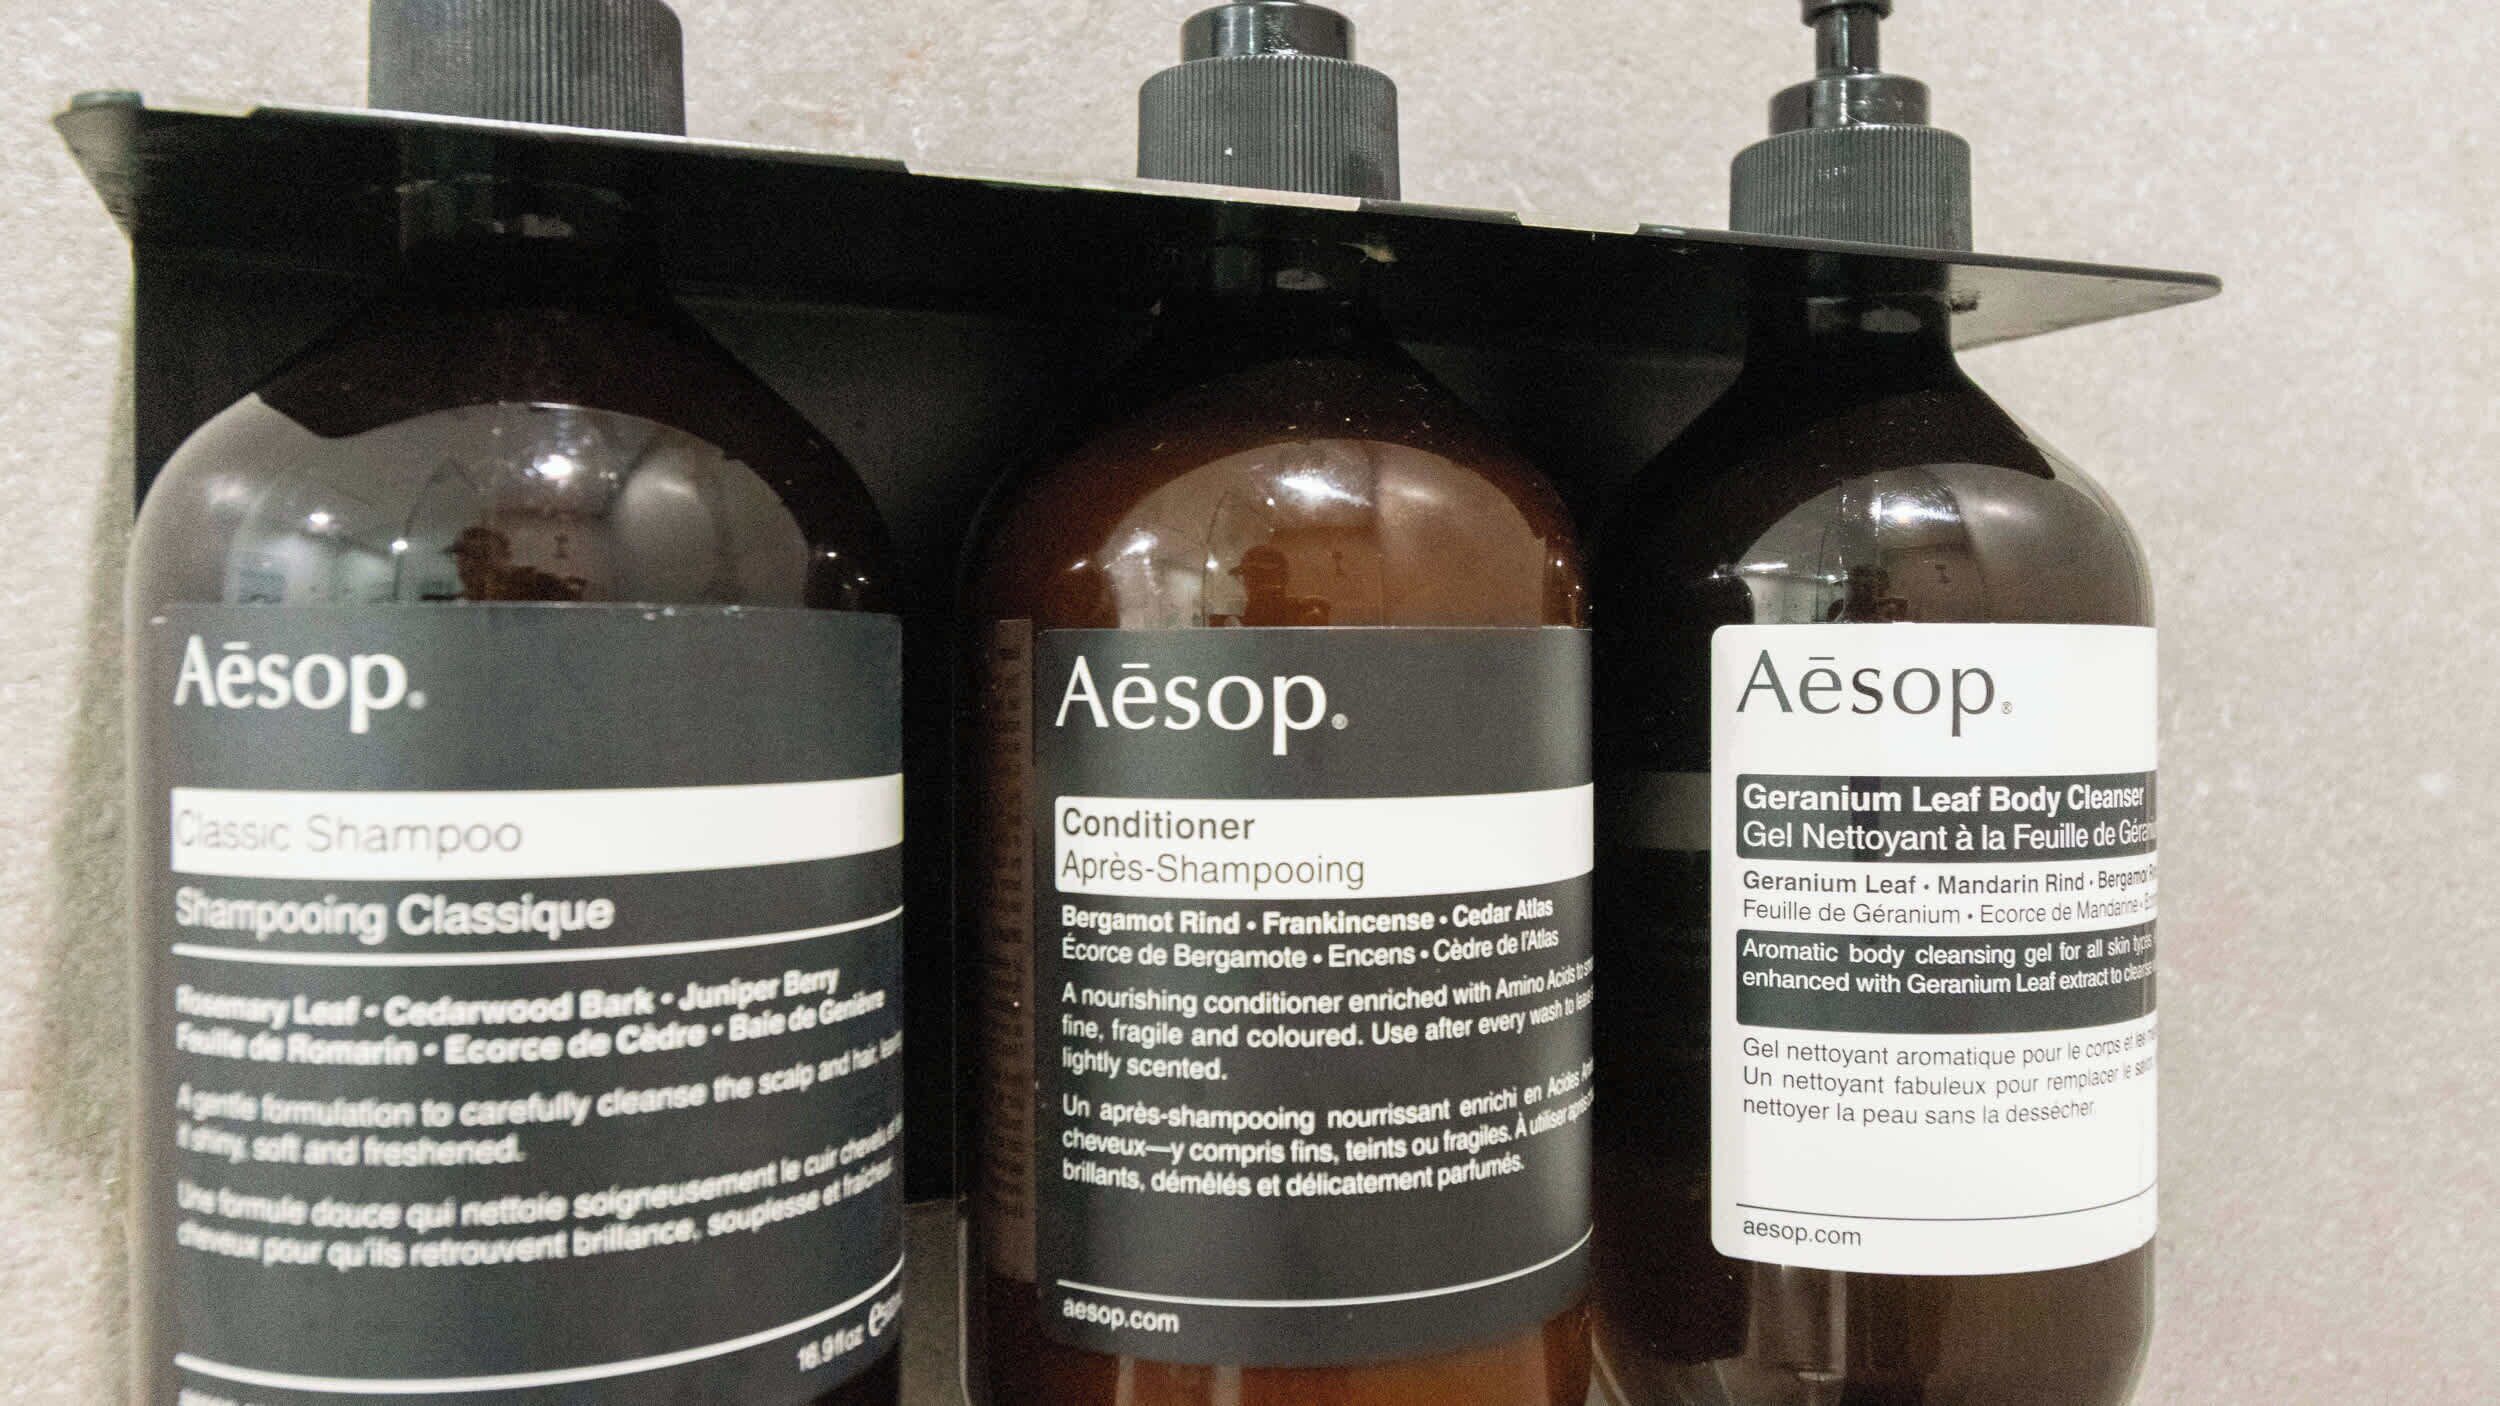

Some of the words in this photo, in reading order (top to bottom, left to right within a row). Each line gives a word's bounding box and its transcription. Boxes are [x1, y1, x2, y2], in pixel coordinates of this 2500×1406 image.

[1743, 783, 1902, 813] Geranium
[1912, 785, 1980, 813] Leaf
[1990, 785, 2061, 817] Body
[2067, 784, 2145, 811] Cleanser
[175, 808, 291, 852] Classic
[306, 813, 523, 861] Shampoo
[1063, 807, 1255, 840] Conditioner
[1743, 821, 1793, 848] Gel
[1802, 823, 1948, 857] Nettoyant
[1955, 823, 1974, 850] à
[1982, 824, 2006, 850] la
[2013, 822, 2089, 849] Feuille
[2093, 821, 2116, 847] de
[1063, 850, 1365, 890] Après-Shampooing
[1743, 870, 1857, 893] Geranium
[1866, 875, 1916, 895] Leaf
[1938, 875, 2039, 895] Mandarin
[2045, 872, 2084, 893] Rind
[175, 886, 388, 945] Shampooing
[398, 893, 615, 941] Classique
[1063, 905, 1173, 935] Bergamot
[1179, 907, 1241, 934] Rind
[1263, 909, 1434, 935] Frankincense
[1453, 902, 1512, 928] Cedar
[1514, 897, 1554, 921] Atlas
[1743, 898, 1812, 921] Feuille
[1819, 901, 1846, 923] de
[1853, 902, 1960, 925] Géranium
[1980, 904, 2044, 924] Ecorce
[2051, 902, 2072, 922] de
[1063, 933, 1133, 964] Écorce
[1138, 941, 1167, 966] de
[1173, 942, 1307, 973] Bergamote
[1328, 943, 1416, 969] Encens
[1433, 936, 1493, 964] Cèdre
[1496, 932, 1518, 956] de
[1743, 938, 1838, 963] Aromatic
[1849, 943, 1904, 971] body
[1915, 944, 2015, 969] cleansing
[2024, 941, 2052, 967] gel
[2059, 938, 2080, 961] for
[2087, 938, 2103, 959] all
[2108, 936, 2130, 956] skin
[293, 994, 361, 1026] Leaf
[384, 991, 574, 1027] Cedarwood
[579, 986, 655, 1020] Bark
[678, 977, 781, 1011] Juniper
[783, 967, 840, 997] Berry
[1063, 981, 1077, 1005] A
[1082, 984, 1197, 1017] nourishing
[1204, 989, 1340, 1015] conditioner
[1349, 986, 1448, 1013] enriched
[1453, 980, 1490, 1006] with
[1496, 974, 1544, 1000] Amino
[1546, 964, 1575, 990] Acids
[1743, 969, 1849, 993] enhanced
[1856, 971, 1901, 993] with
[1907, 972, 2011, 995] Geranium
[2016, 969, 2056, 993] Leaf
[2060, 967, 2108, 990] extract
[2111, 966, 2122, 985] to
[249, 1031, 285, 1062] de
[287, 1032, 418, 1065] Romarin
[444, 1032, 564, 1065] Ecorce
[567, 1028, 612, 1059] de
[616, 1021, 707, 1055] Cèdre
[729, 1009, 786, 1041] Baie
[788, 1004, 817, 1031] de
[1063, 1014, 1104, 1041] fine,
[1112, 1019, 1182, 1050] fragile
[1192, 1025, 1238, 1048] and
[1247, 1022, 1363, 1048] coloured.
[1371, 1020, 1418, 1046] Use
[1425, 1018, 1471, 1042] after
[1478, 1010, 1526, 1036] every
[1529, 1000, 1563, 1025] wash
[1565, 997, 1575, 1016] to
[1063, 1046, 1121, 1078] lightly
[1127, 1055, 1227, 1082] scented.
[1743, 1037, 1779, 1059] Gel
[1787, 1042, 1889, 1066] nettoyant
[1896, 1045, 2015, 1069] aromatique
[2023, 1046, 2061, 1068] pour
[2068, 1041, 2080, 1060] le
[2086, 1038, 2121, 1059] corps
[261, 1093, 416, 1128] formulation
[420, 1098, 454, 1127] to
[459, 1091, 591, 1127] carefully
[596, 1084, 708, 1117] cleanse
[713, 1074, 754, 1103] the
[757, 1062, 815, 1095] scalp
[818, 1050, 850, 1082] and
[1743, 1066, 1772, 1086] Un
[1782, 1070, 1884, 1096] nettoyant
[1895, 1074, 1985, 1096] fabuleux
[1996, 1077, 2037, 1099] pour
[2047, 1066, 2119, 1095] remplacer
[1063, 1093, 1090, 1118] Un
[1100, 1098, 1315, 1134] après-shampooing
[1327, 1101, 1450, 1129] nourrissant
[1459, 1086, 1517, 1116] enrichi
[1524, 1085, 1542, 1105] en
[1743, 1097, 1829, 1121] nettoyer
[1837, 1102, 1855, 1122] la
[1863, 1107, 1917, 1127] peau
[1925, 1109, 1975, 1125] sans
[1983, 1105, 1999, 1124] la
[303, 1135, 360, 1166] and
[363, 1133, 527, 1167] freshened.
[1189, 1138, 1285, 1168] compris
[1291, 1138, 1340, 1165] fins,
[1346, 1134, 1407, 1161] teints
[1412, 1134, 1439, 1158] ou
[1443, 1122, 1512, 1155] fragiles.
[1515, 1111, 1528, 1139] À
[1529, 1107, 1568, 1135] utiliser
[311, 1197, 400, 1228] douce
[405, 1196, 456, 1234] qui
[461, 1191, 567, 1226] nettoie
[573, 1161, 777, 1220] soigneusement
[780, 1157, 801, 1184] le
[803, 1145, 837, 1177] cuir
[1063, 1159, 1144, 1192] brillants,
[1151, 1167, 1251, 1197] démêlés
[1256, 1173, 1281, 1197] et
[1286, 1166, 1433, 1197] délicatement
[1437, 1152, 1525, 1191] parfumés.
[263, 1237, 324, 1268] pour
[409, 1230, 568, 1268] retrouvent
[707, 1198, 821, 1237] souplesse
[1743, 1218, 1861, 1246] aesop.com
[1063, 1297, 1180, 1334] aesop.com
